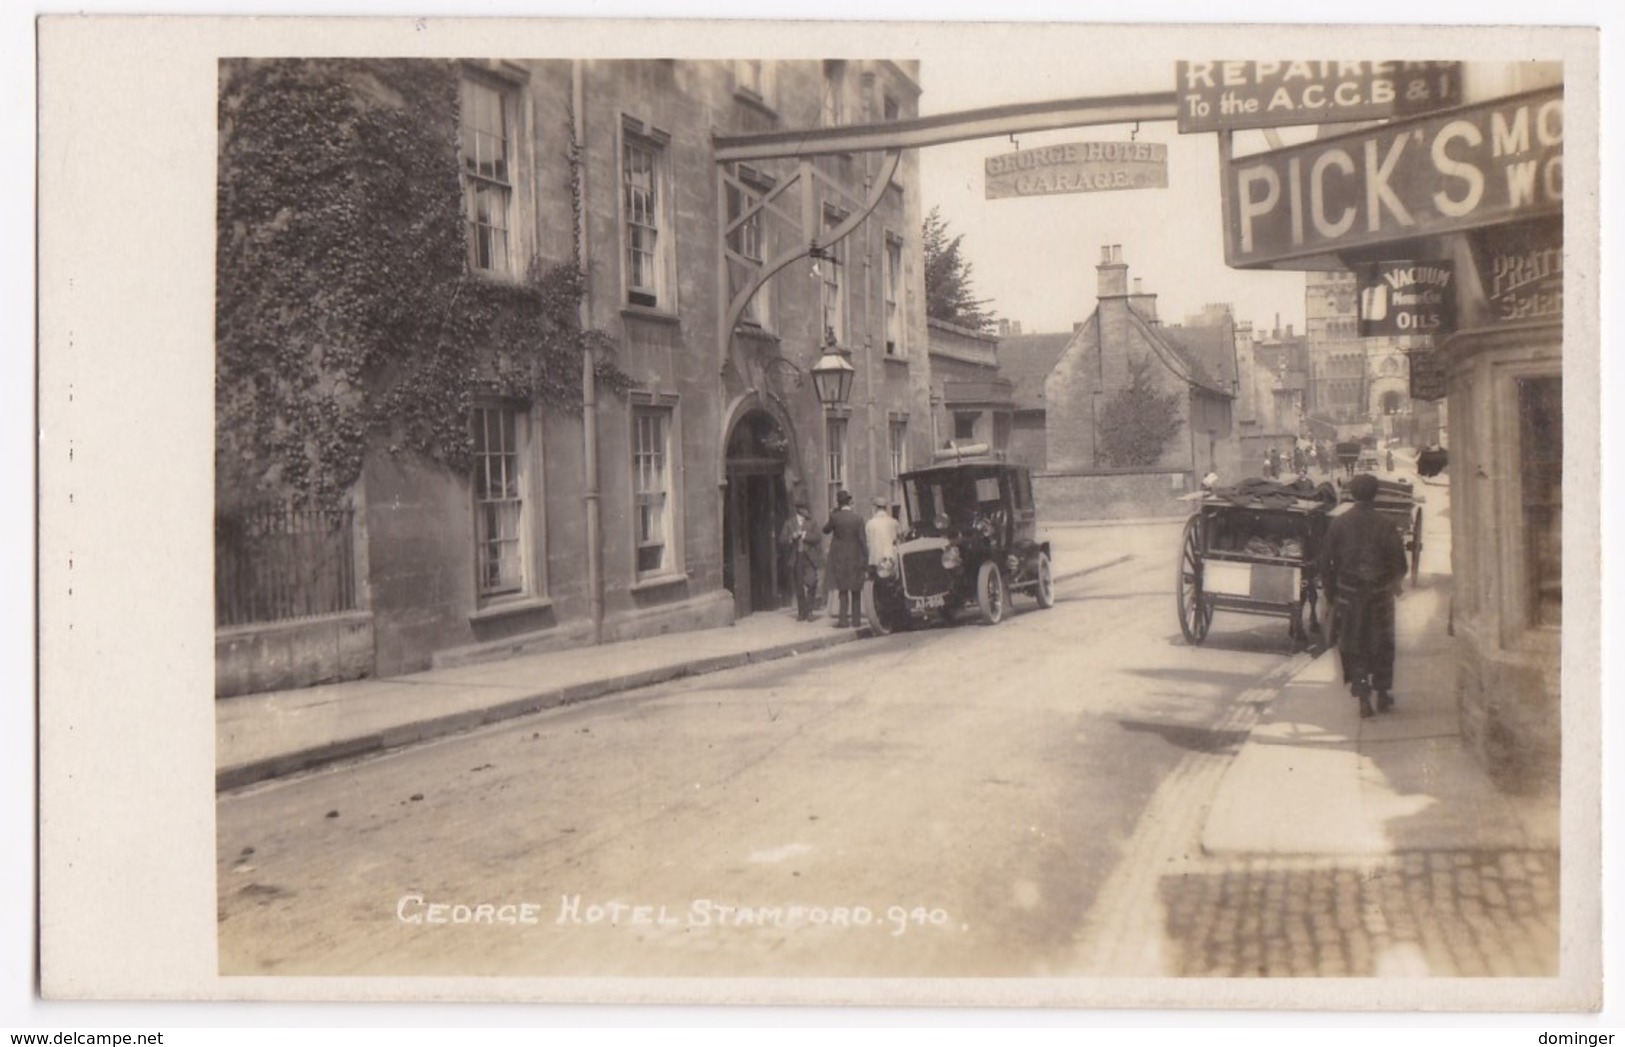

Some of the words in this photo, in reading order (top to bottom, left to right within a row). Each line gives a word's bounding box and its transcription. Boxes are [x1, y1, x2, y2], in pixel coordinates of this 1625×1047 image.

[1186, 94, 1210, 117] To
[1220, 91, 1259, 115] the
[1406, 79, 1430, 100] &
[985, 144, 1077, 177] GEORGE
[1086, 142, 1167, 164] HOTEL
[1238, 120, 1485, 253] PICK'S
[1383, 267, 1451, 289] VACUUM
[1396, 312, 1440, 329] OILS
